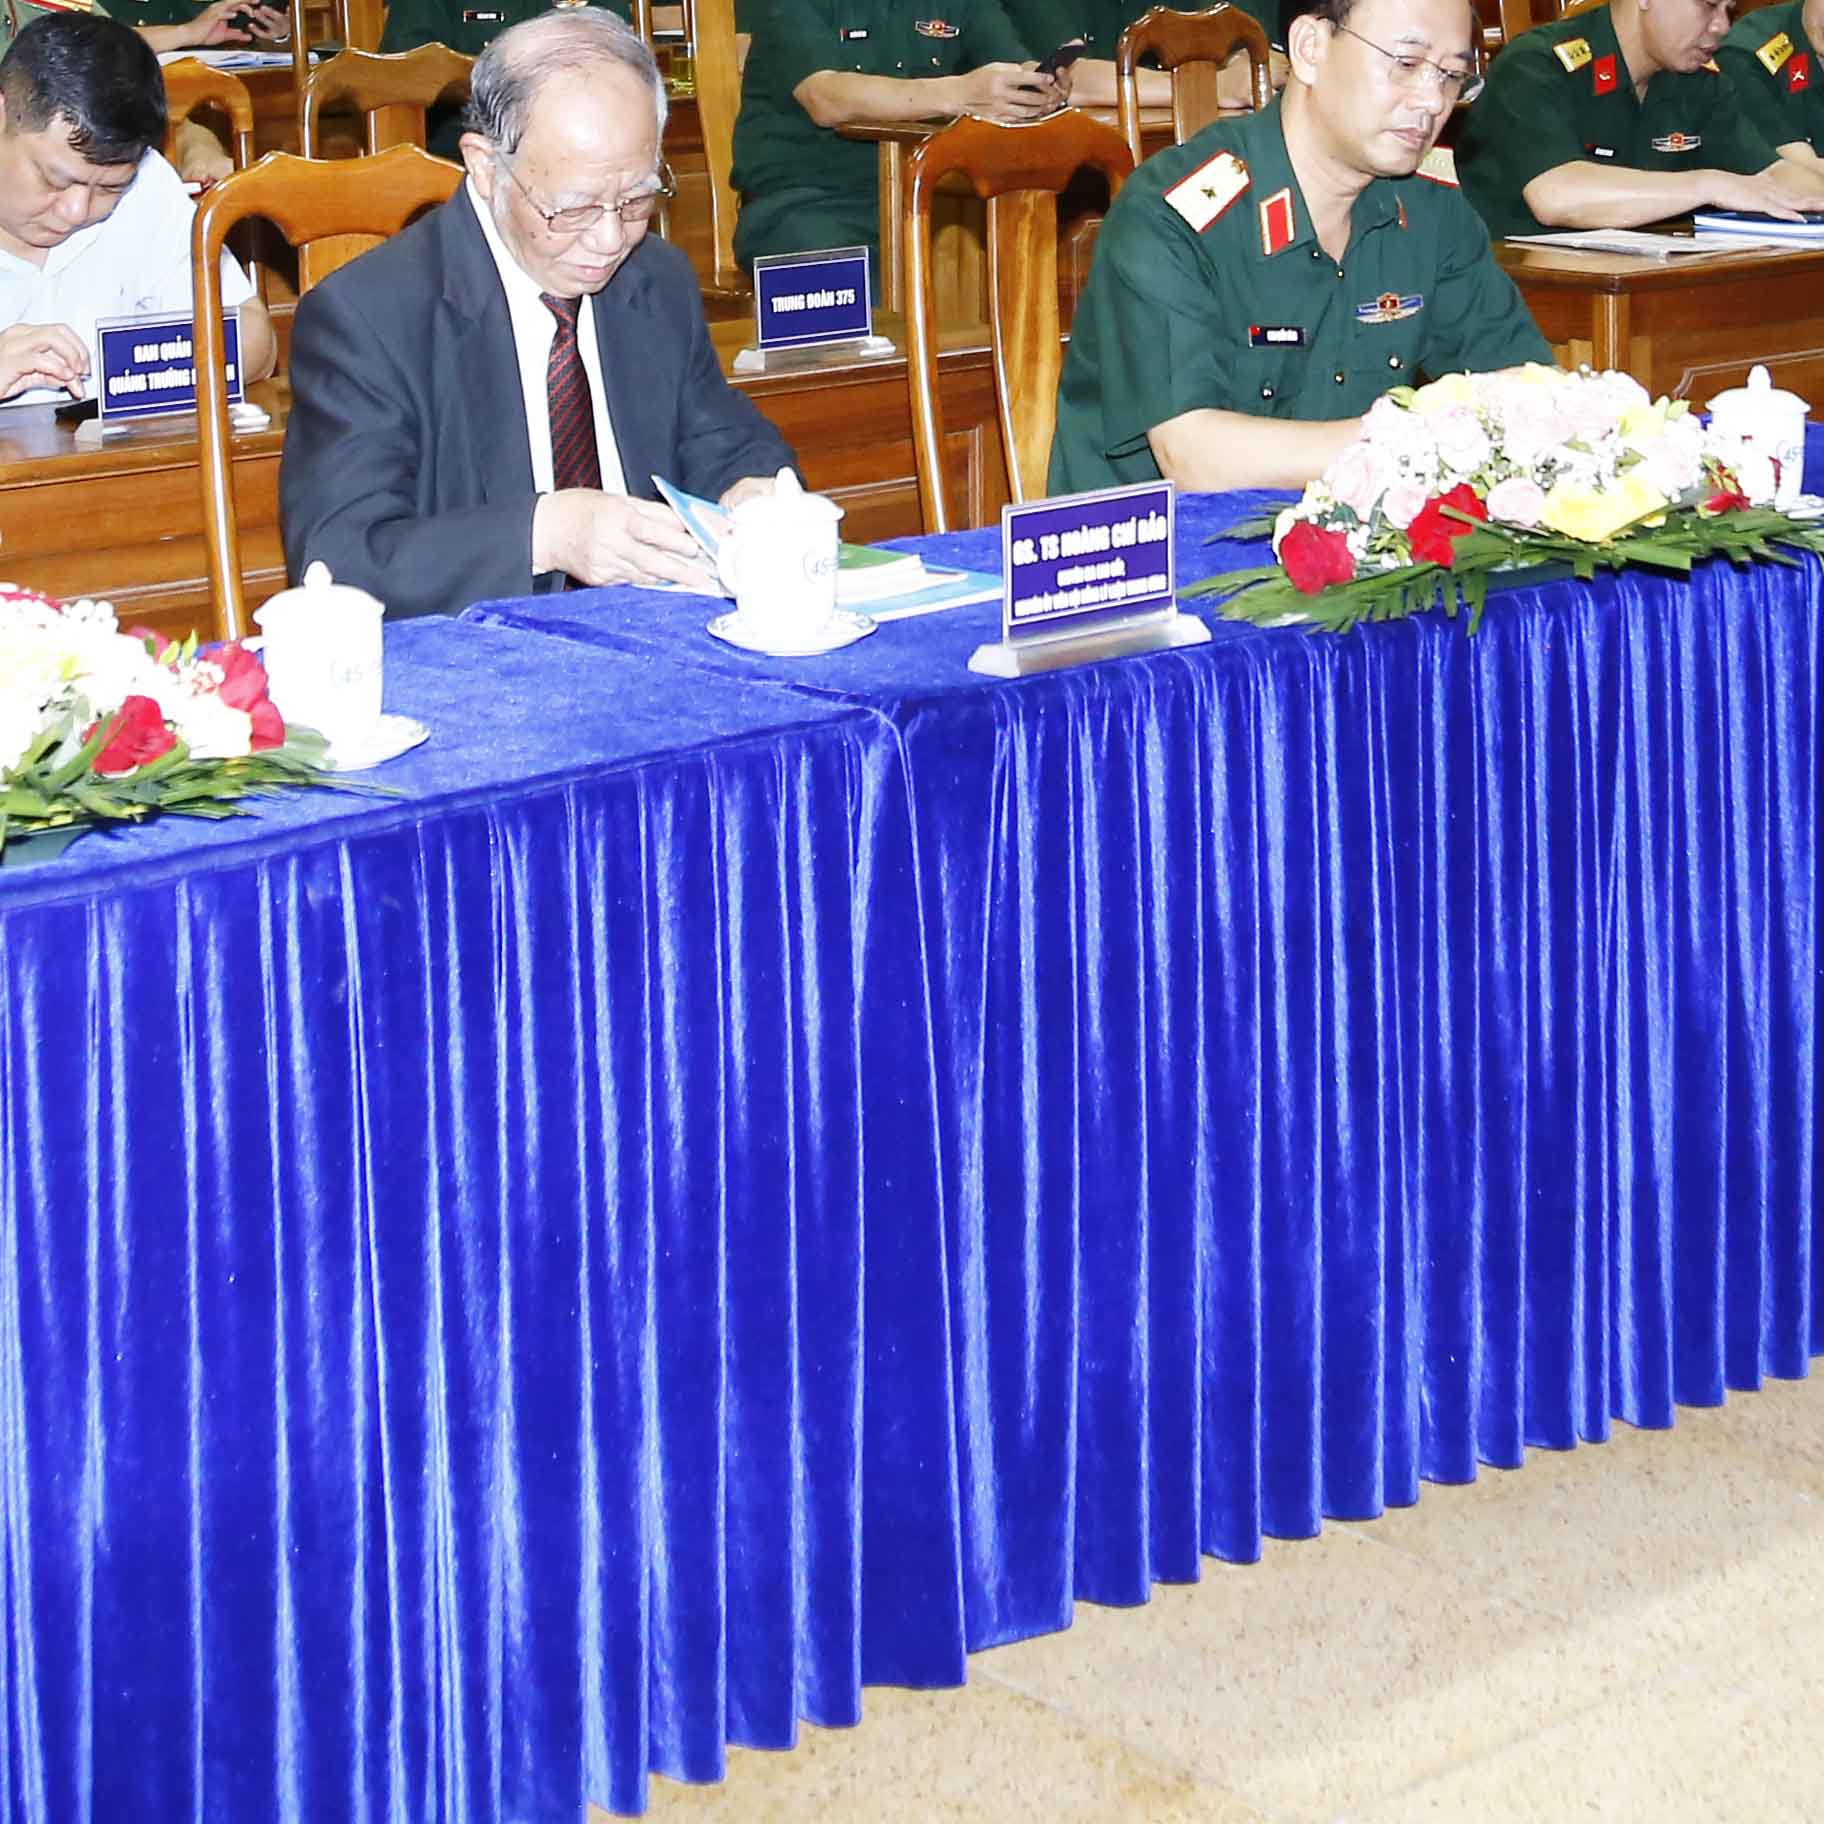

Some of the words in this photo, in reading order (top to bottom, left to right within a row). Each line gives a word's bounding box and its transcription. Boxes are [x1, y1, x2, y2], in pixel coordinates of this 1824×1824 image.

[771, 294, 806, 313] TRUNG
[806, 288, 835, 310] ĐOÀN
[835, 288, 856, 307] 375
